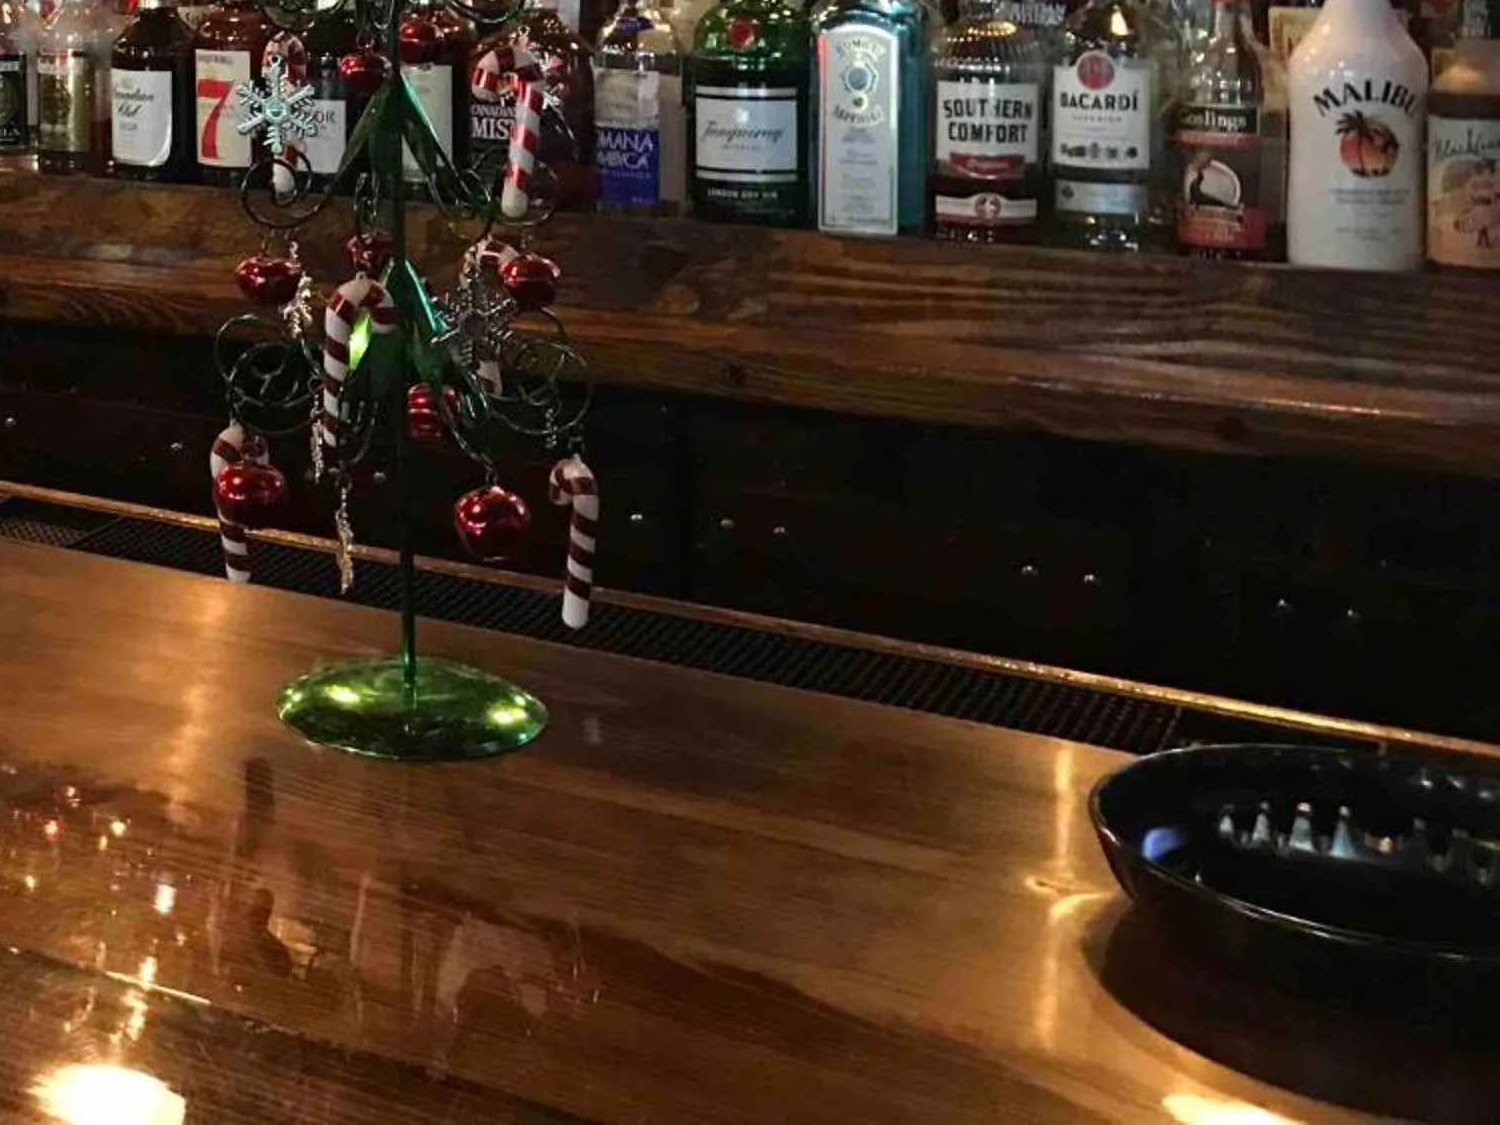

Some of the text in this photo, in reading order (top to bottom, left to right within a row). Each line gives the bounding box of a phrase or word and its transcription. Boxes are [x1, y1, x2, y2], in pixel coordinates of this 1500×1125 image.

[1060, 88, 1140, 112] BACARDÍ
[1313, 79, 1418, 118] MALIBU
[197, 78, 236, 160] 7
[947, 120, 1028, 144] COMFORT
